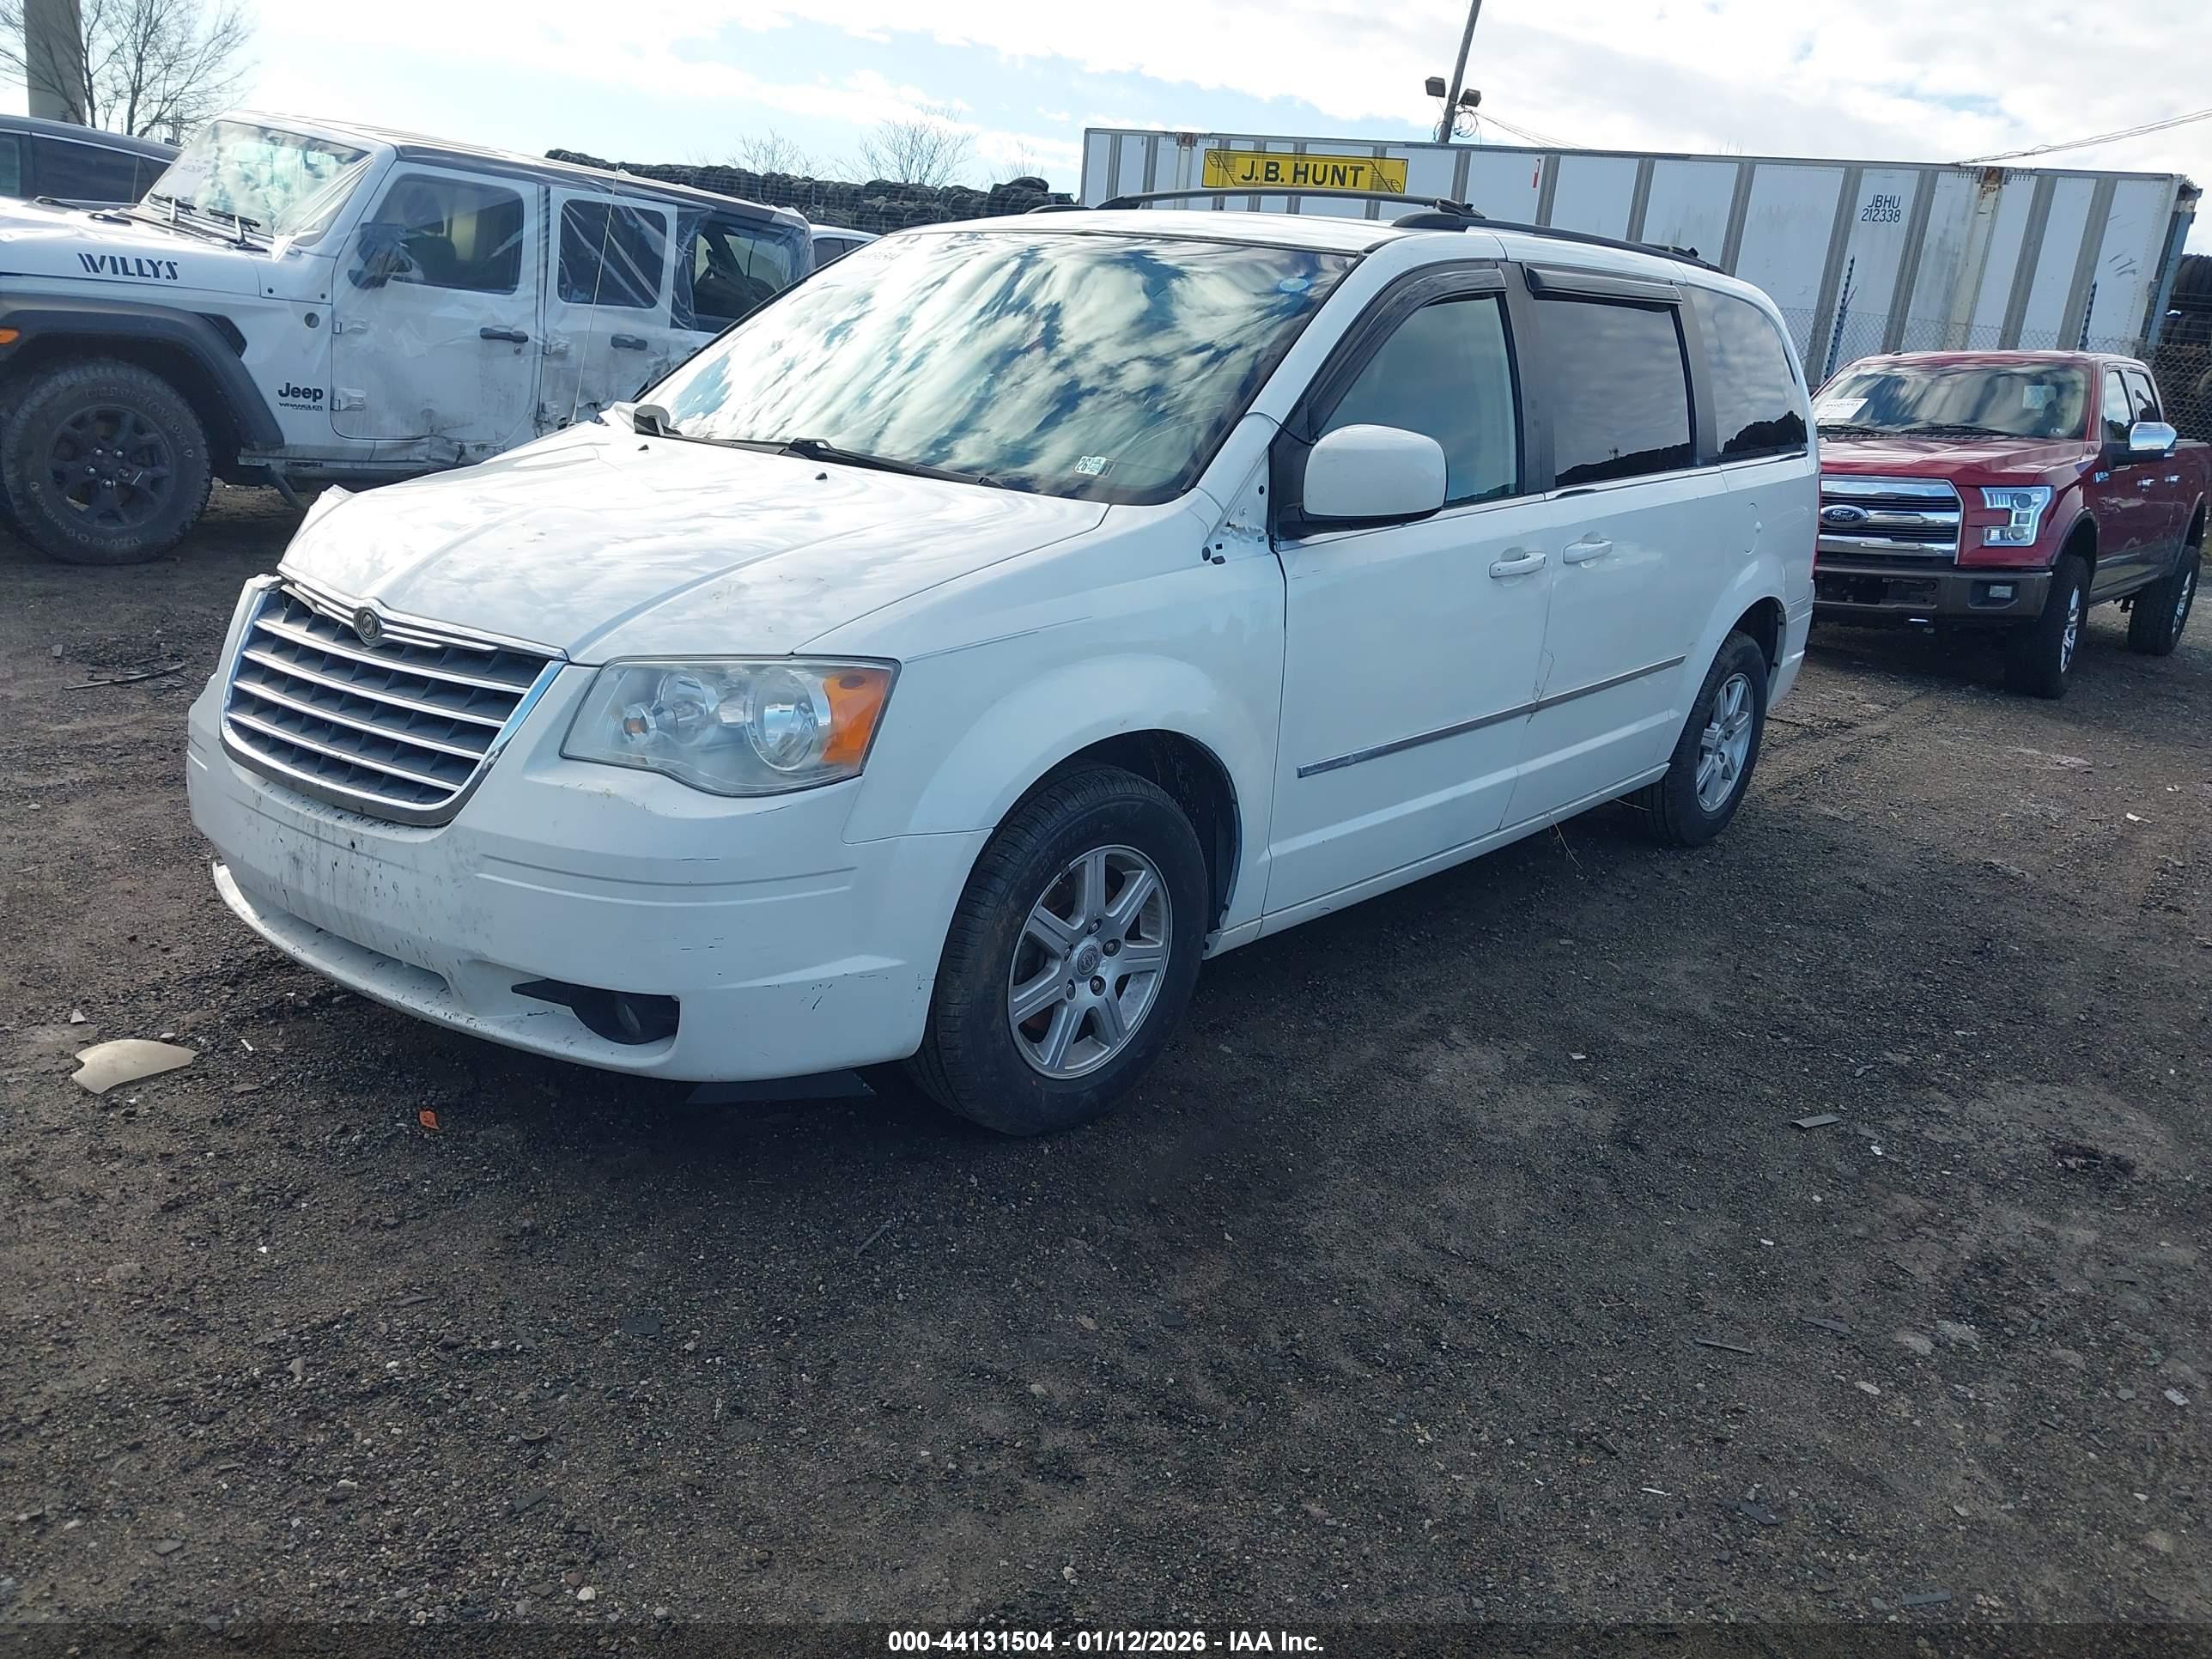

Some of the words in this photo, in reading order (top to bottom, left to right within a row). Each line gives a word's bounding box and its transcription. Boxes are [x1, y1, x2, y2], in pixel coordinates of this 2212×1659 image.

[1241, 161, 1285, 183] J.B.
[1292, 162, 1364, 187] HUNT
[1867, 194, 1901, 209] JBHU
[1861, 208, 1901, 223] 212338
[76, 252, 179, 281] WILLYS
[277, 382, 324, 403] Jeep
[1829, 509, 1856, 522] Ford
